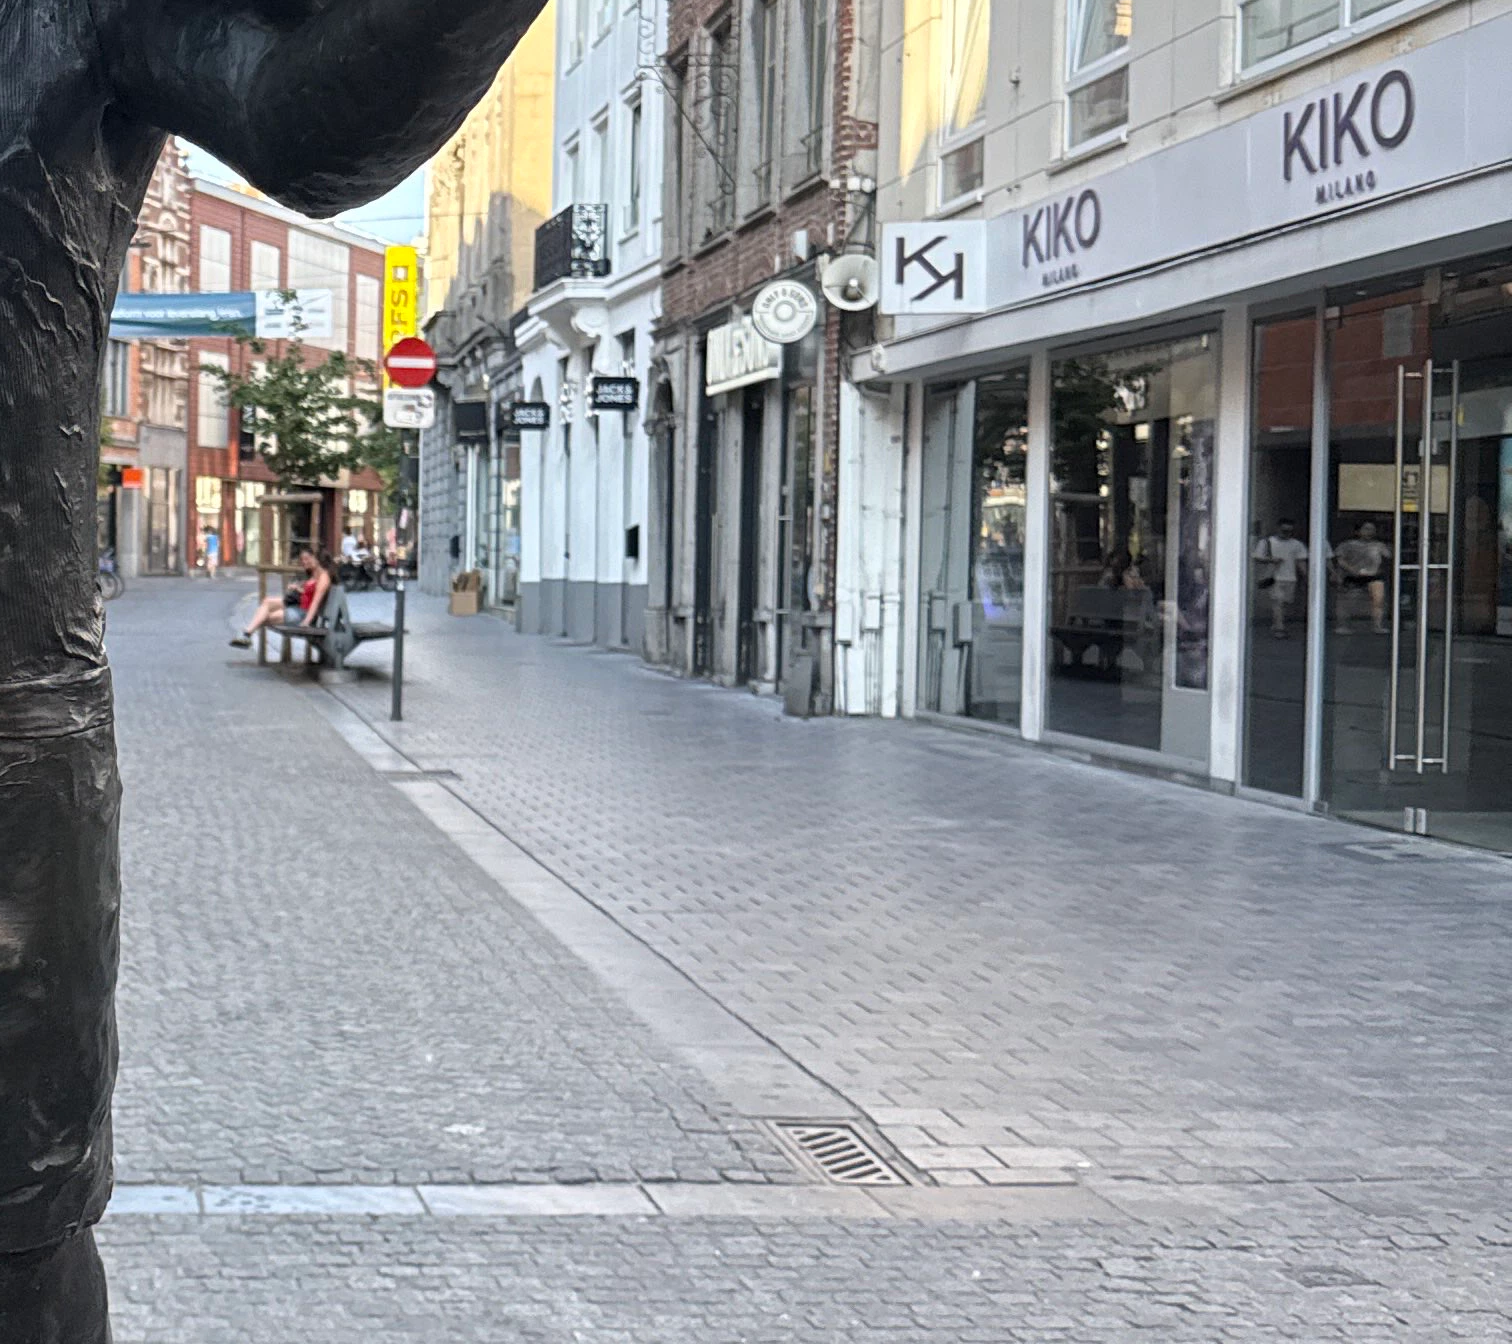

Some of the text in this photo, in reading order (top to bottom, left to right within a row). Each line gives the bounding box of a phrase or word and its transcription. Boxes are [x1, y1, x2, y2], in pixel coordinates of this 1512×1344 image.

[1283, 69, 1415, 182] KIKO
[1316, 170, 1376, 204] MILANO
[1022, 188, 1101, 269] KIKO
[1042, 264, 1080, 287] MILANO
